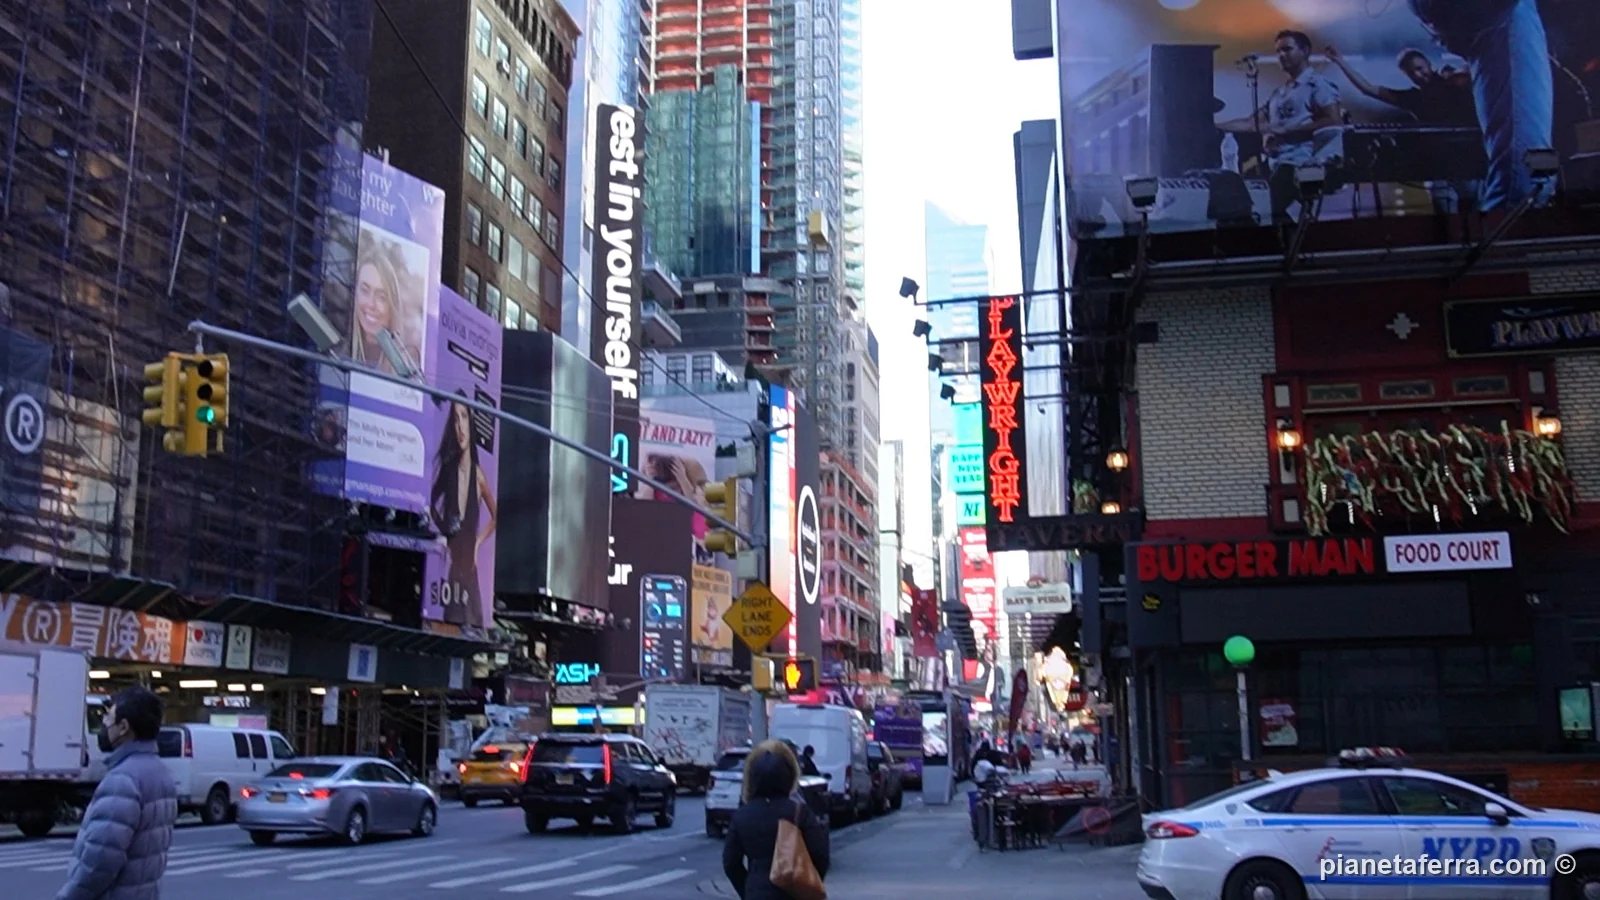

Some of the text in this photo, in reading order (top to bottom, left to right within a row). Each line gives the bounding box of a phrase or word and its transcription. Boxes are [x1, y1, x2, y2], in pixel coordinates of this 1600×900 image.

[369, 171, 393, 197] my
[607, 182, 641, 222] in
[600, 224, 638, 400] yourself
[983, 296, 1021, 523] PLAYWRIGHT
[651, 424, 677, 442] AND
[680, 428, 713, 448] LAZY?
[995, 521, 1132, 547] TAVERN
[1136, 537, 1375, 582] BURGER MAN
[1394, 539, 1500, 565] FOOD COURT
[741, 597, 773, 608] RIGHT
[741, 611, 773, 622] LANE
[742, 625, 772, 637] ENDS
[1422, 836, 1522, 868] NYPD
